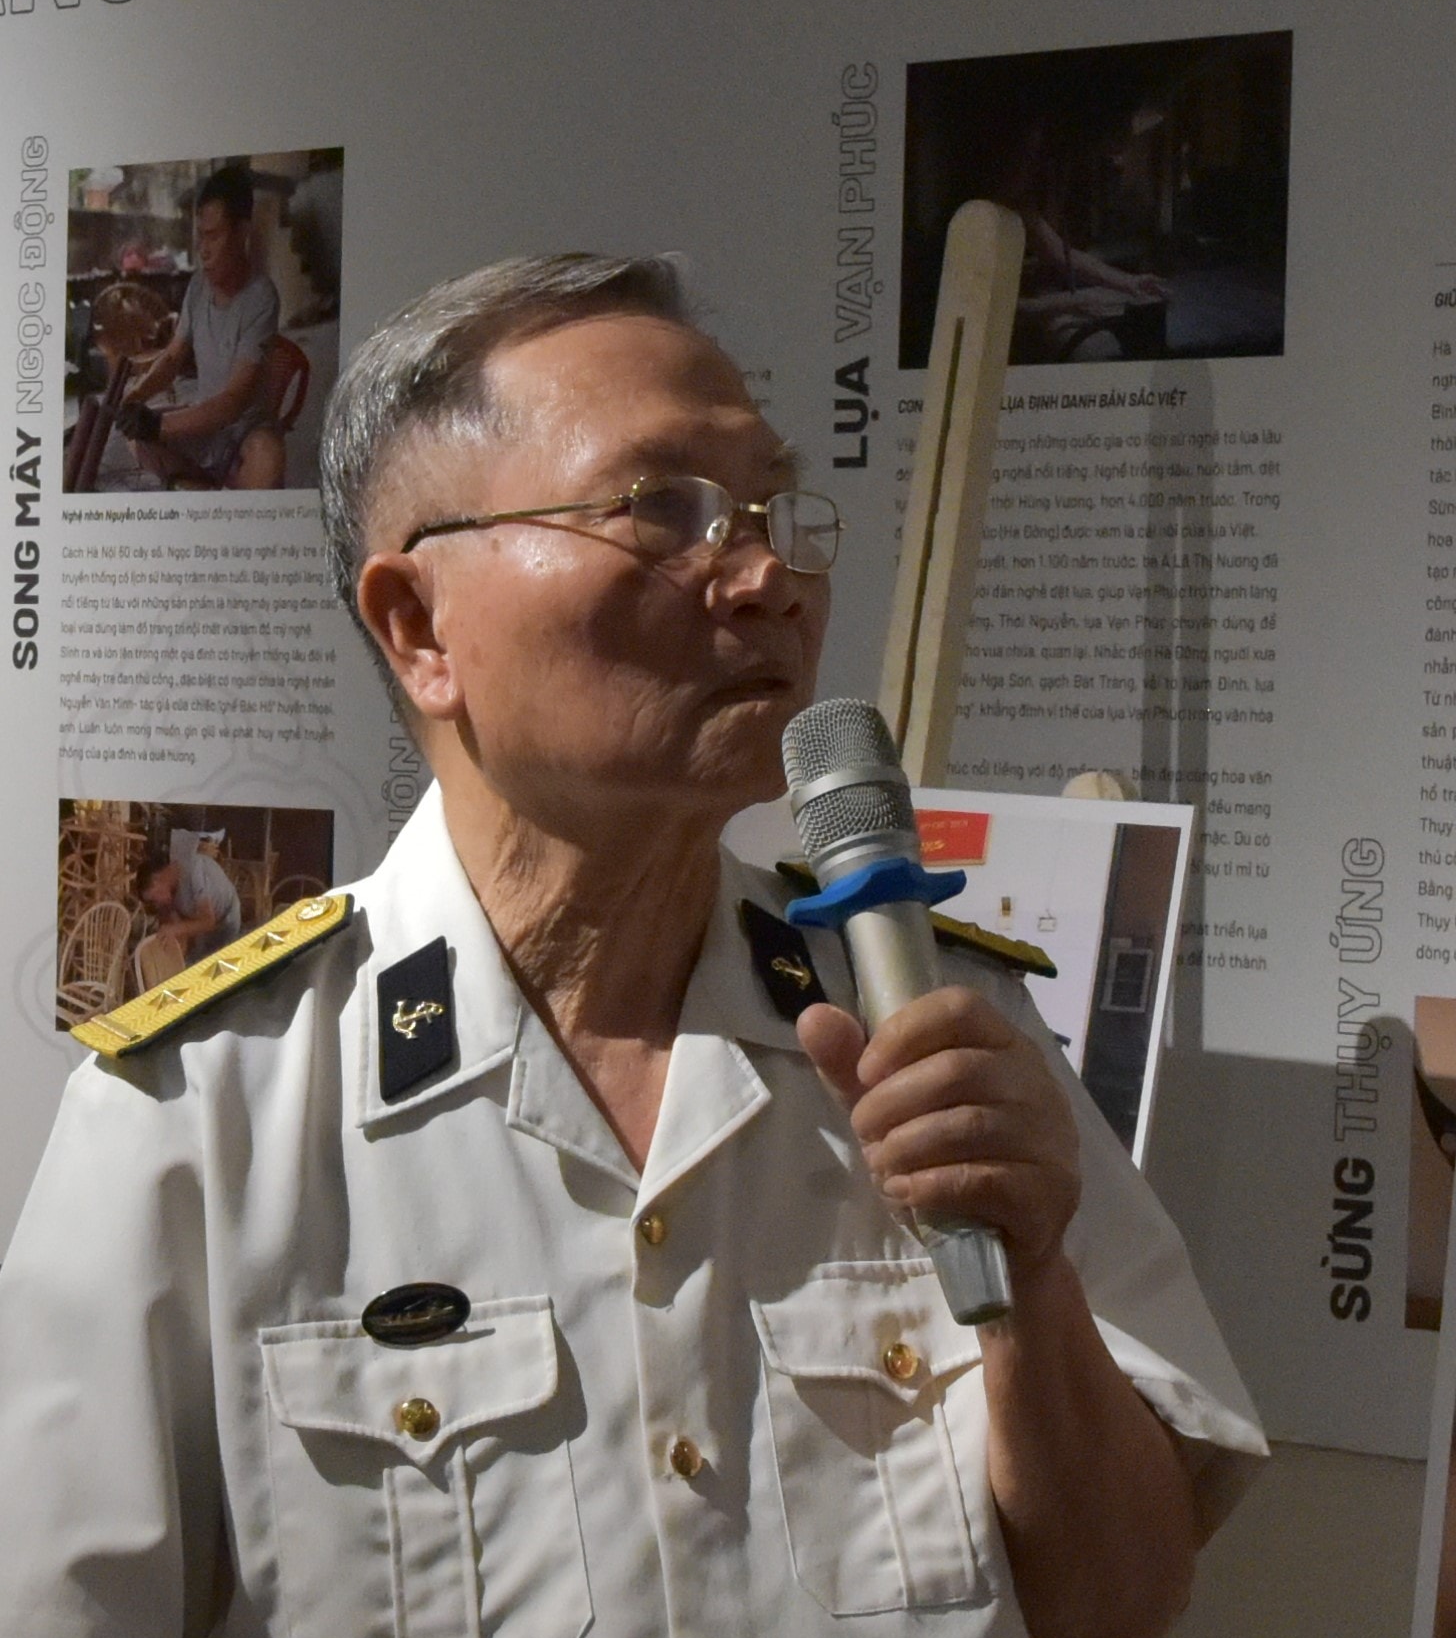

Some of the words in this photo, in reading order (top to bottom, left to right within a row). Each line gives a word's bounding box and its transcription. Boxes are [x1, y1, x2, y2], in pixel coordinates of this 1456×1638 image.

[14, 135, 55, 271] ĐỘNG
[831, 61, 880, 214] PHÚC
[15, 280, 53, 414] NGỌC
[834, 226, 883, 344] VẠN
[9, 427, 43, 527] MÂY
[832, 356, 880, 470] LỤA
[13, 539, 42, 672] SONG
[1330, 837, 1386, 964] ỨNG
[1333, 977, 1393, 1142] THỤY
[1321, 1156, 1376, 1323] SỪNG
